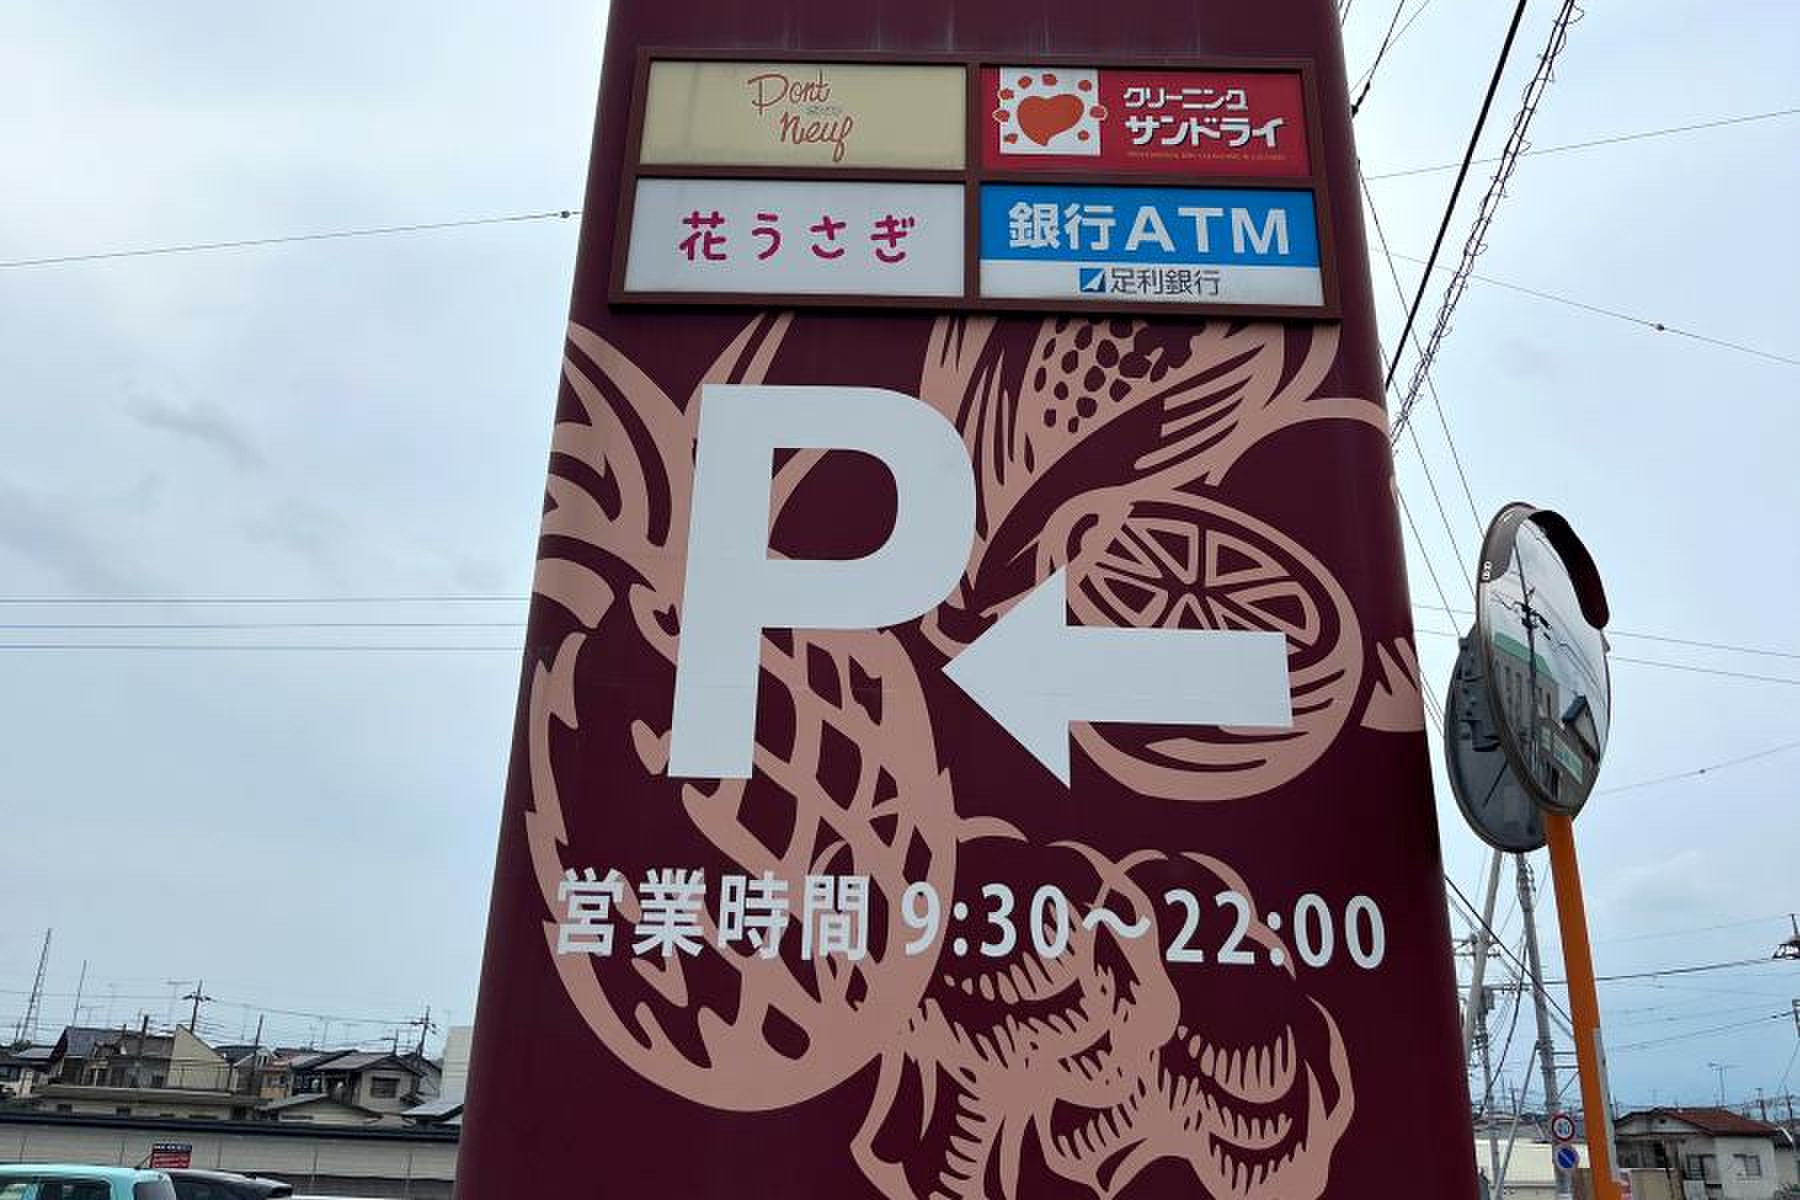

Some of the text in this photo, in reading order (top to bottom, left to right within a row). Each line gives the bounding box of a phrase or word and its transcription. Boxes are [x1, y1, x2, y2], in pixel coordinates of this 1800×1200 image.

[747, 69, 830, 115] Pont
[1123, 87, 1249, 110] クリーニング
[1124, 115, 1284, 148] サンドライ
[679, 211, 914, 263] 花うさぎ
[1110, 267, 1221, 296] 足利銀行
[667, 383, 977, 779] P
[556, 867, 870, 961] 営業時間
